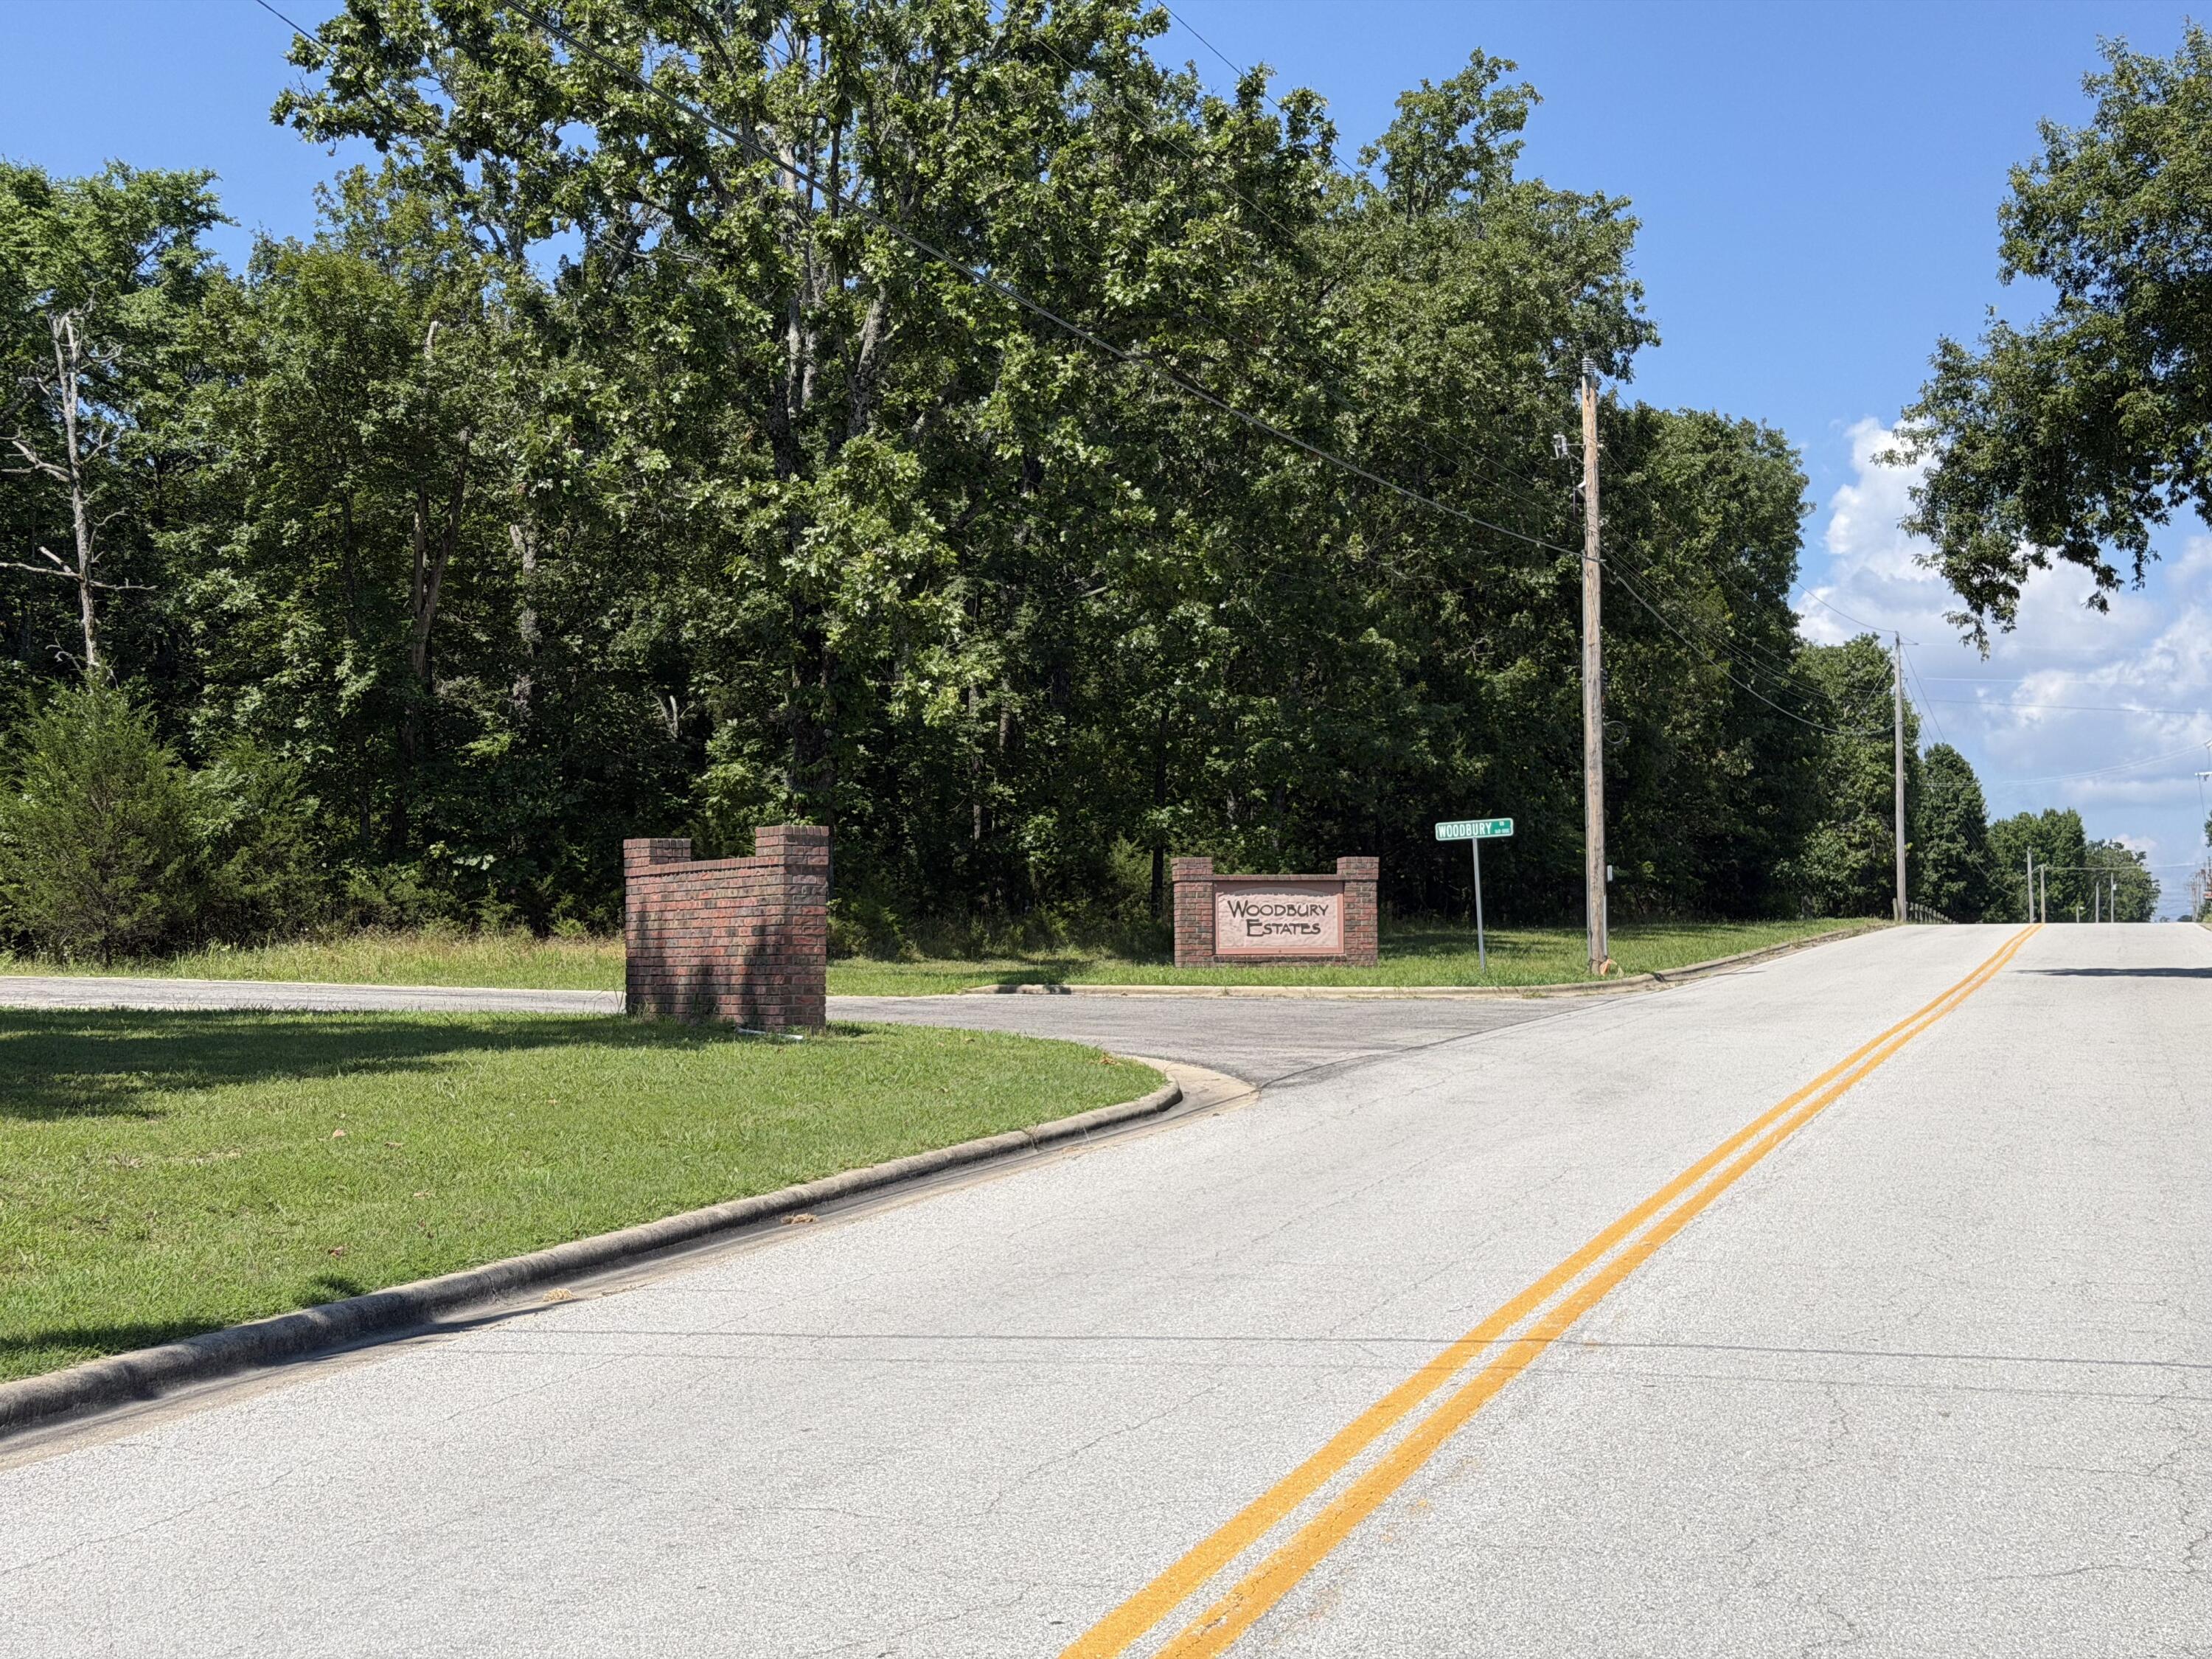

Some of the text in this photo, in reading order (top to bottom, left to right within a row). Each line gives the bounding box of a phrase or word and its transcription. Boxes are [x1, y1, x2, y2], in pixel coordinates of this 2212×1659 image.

[1439, 822, 1492, 838] WOODBURY
[1228, 900, 1329, 918] WOODBURY
[1246, 919, 1321, 936] ESTATES
